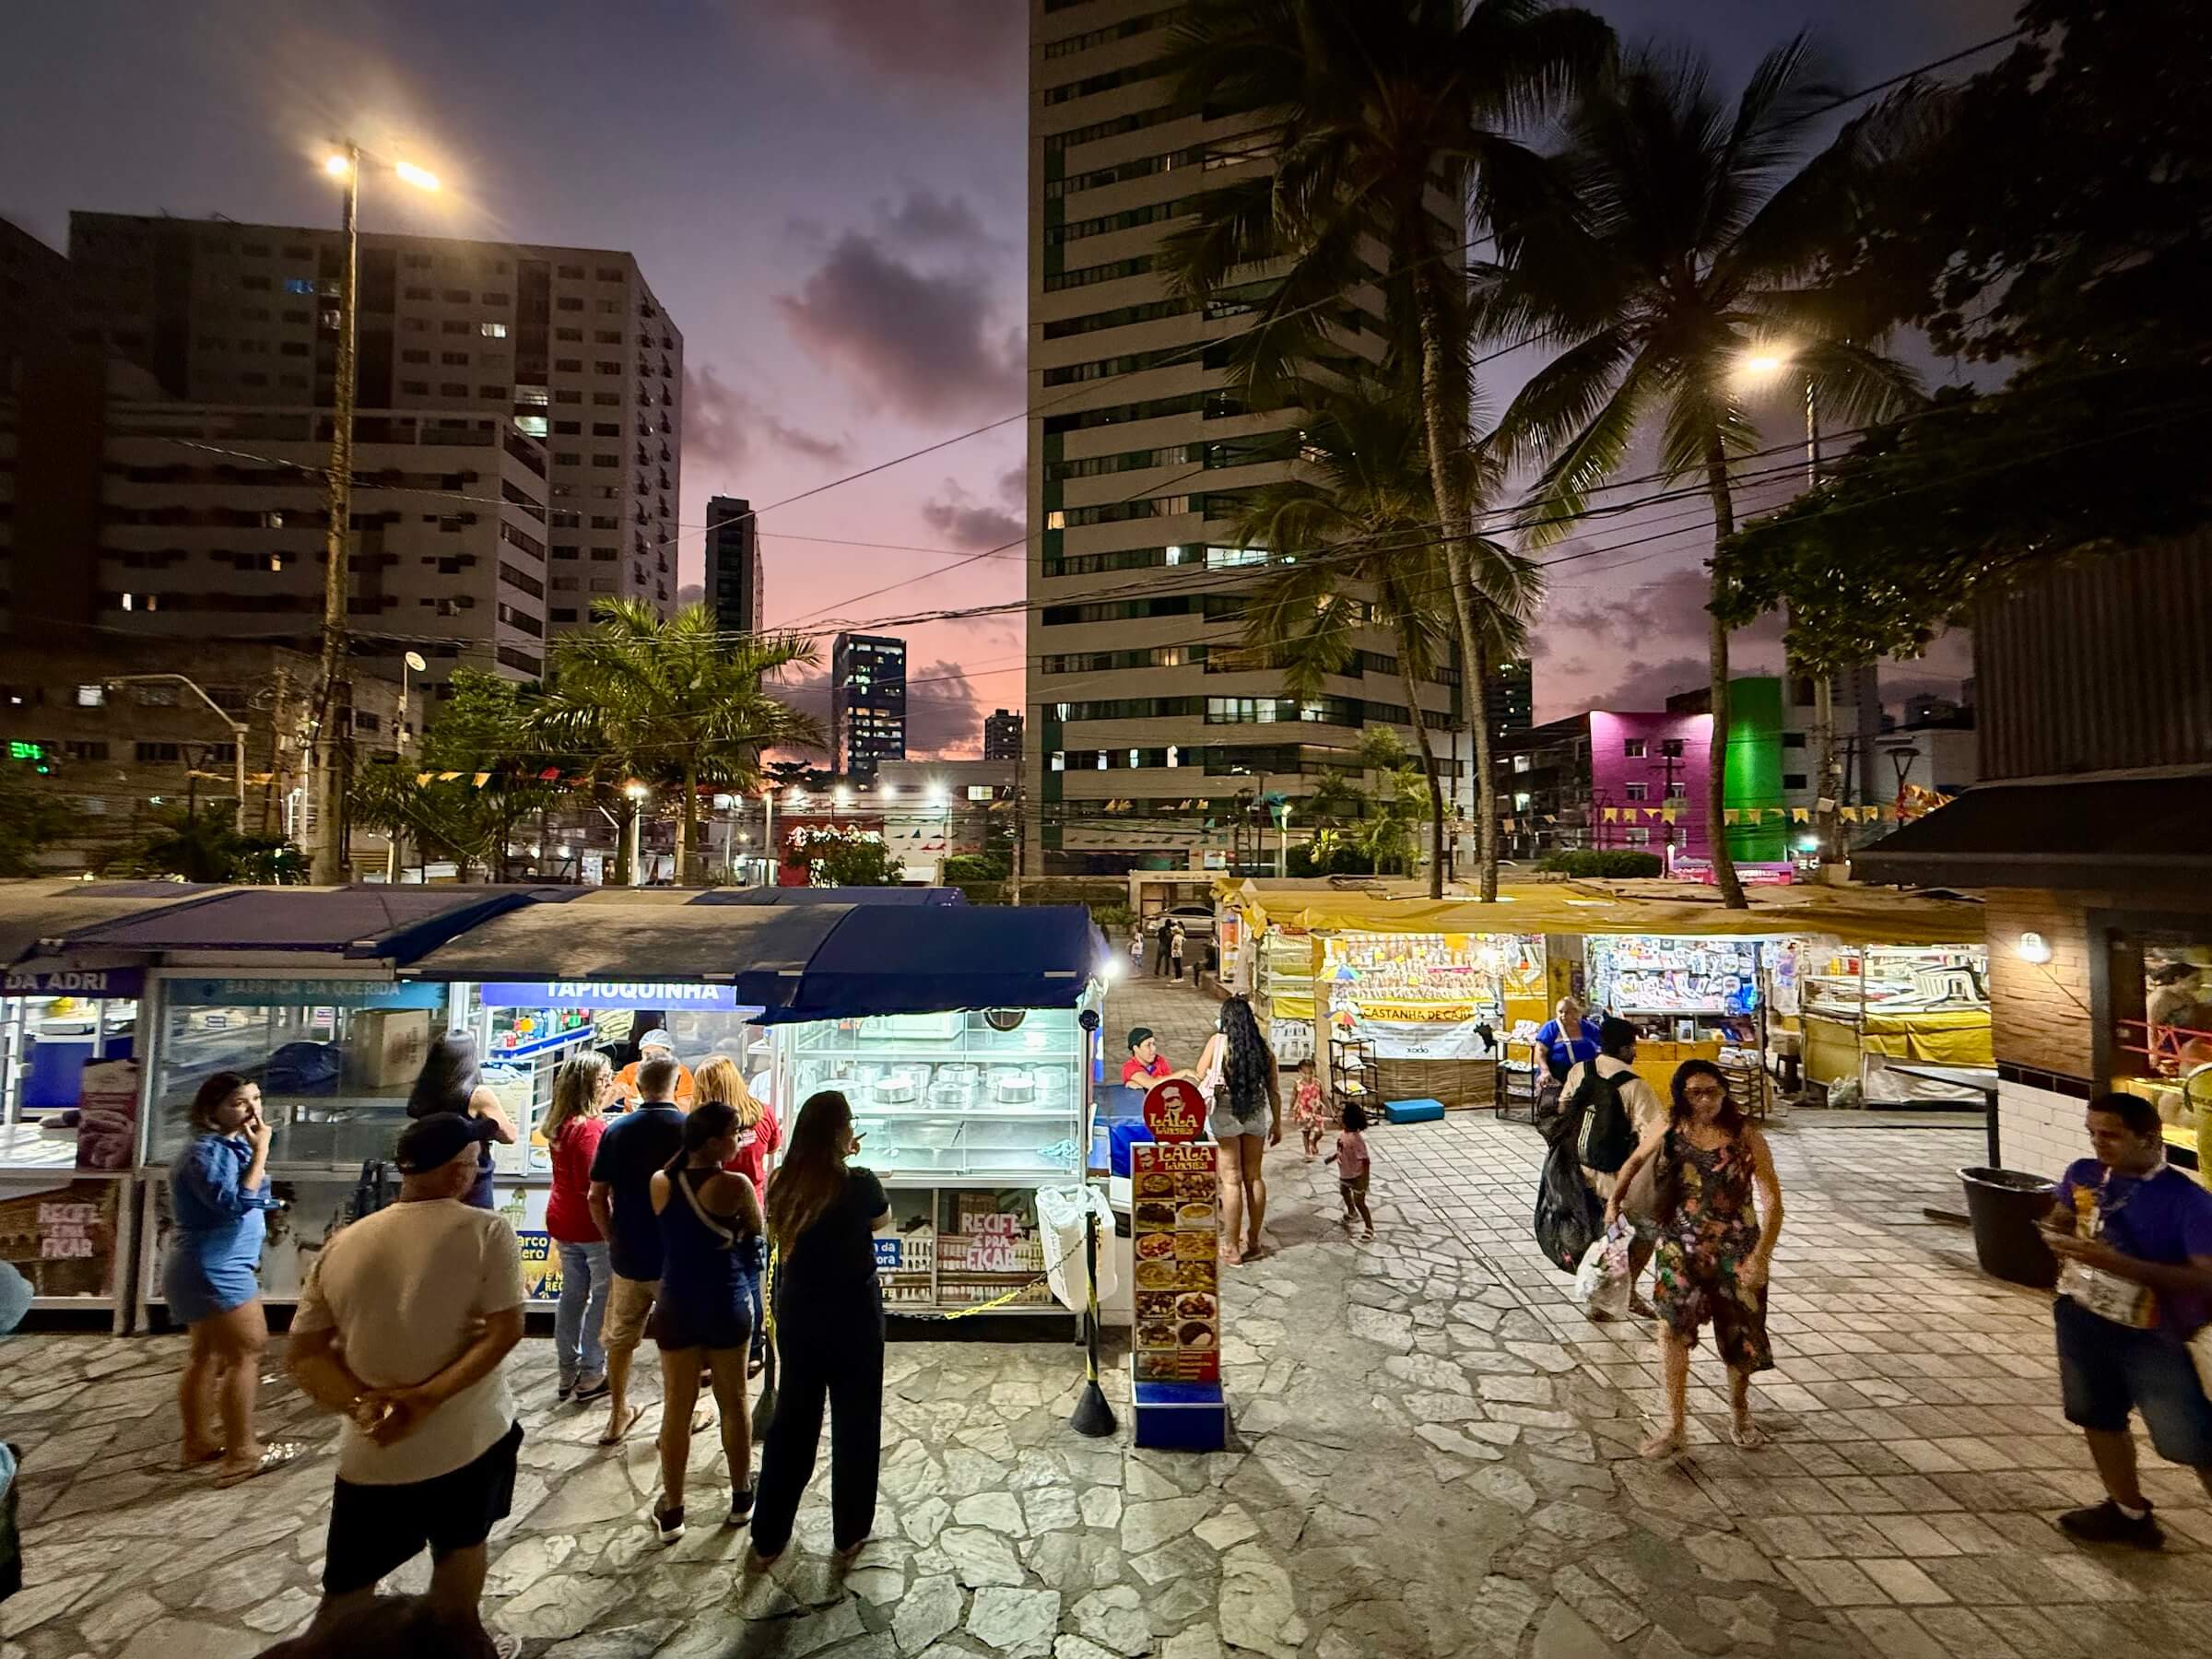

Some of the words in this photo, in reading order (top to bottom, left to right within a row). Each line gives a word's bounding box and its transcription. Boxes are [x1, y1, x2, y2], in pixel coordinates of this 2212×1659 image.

[11, 742, 41, 759] 34
[48, 972, 107, 990] ADRI
[547, 982, 719, 1000] TAPIOQUINHA
[1364, 1008, 1425, 1019] CASTANHA
[1428, 1010, 1440, 1019] DE
[1149, 1113, 1199, 1127] LALA
[1158, 1147, 1214, 1161] LALA
[962, 1213, 1022, 1234] RECIFE
[517, 1236, 548, 1247] arco
[881, 1242, 896, 1252] da
[522, 1249, 545, 1259] ero
[877, 1255, 896, 1265] ora
[967, 1248, 1017, 1271] FICAR
